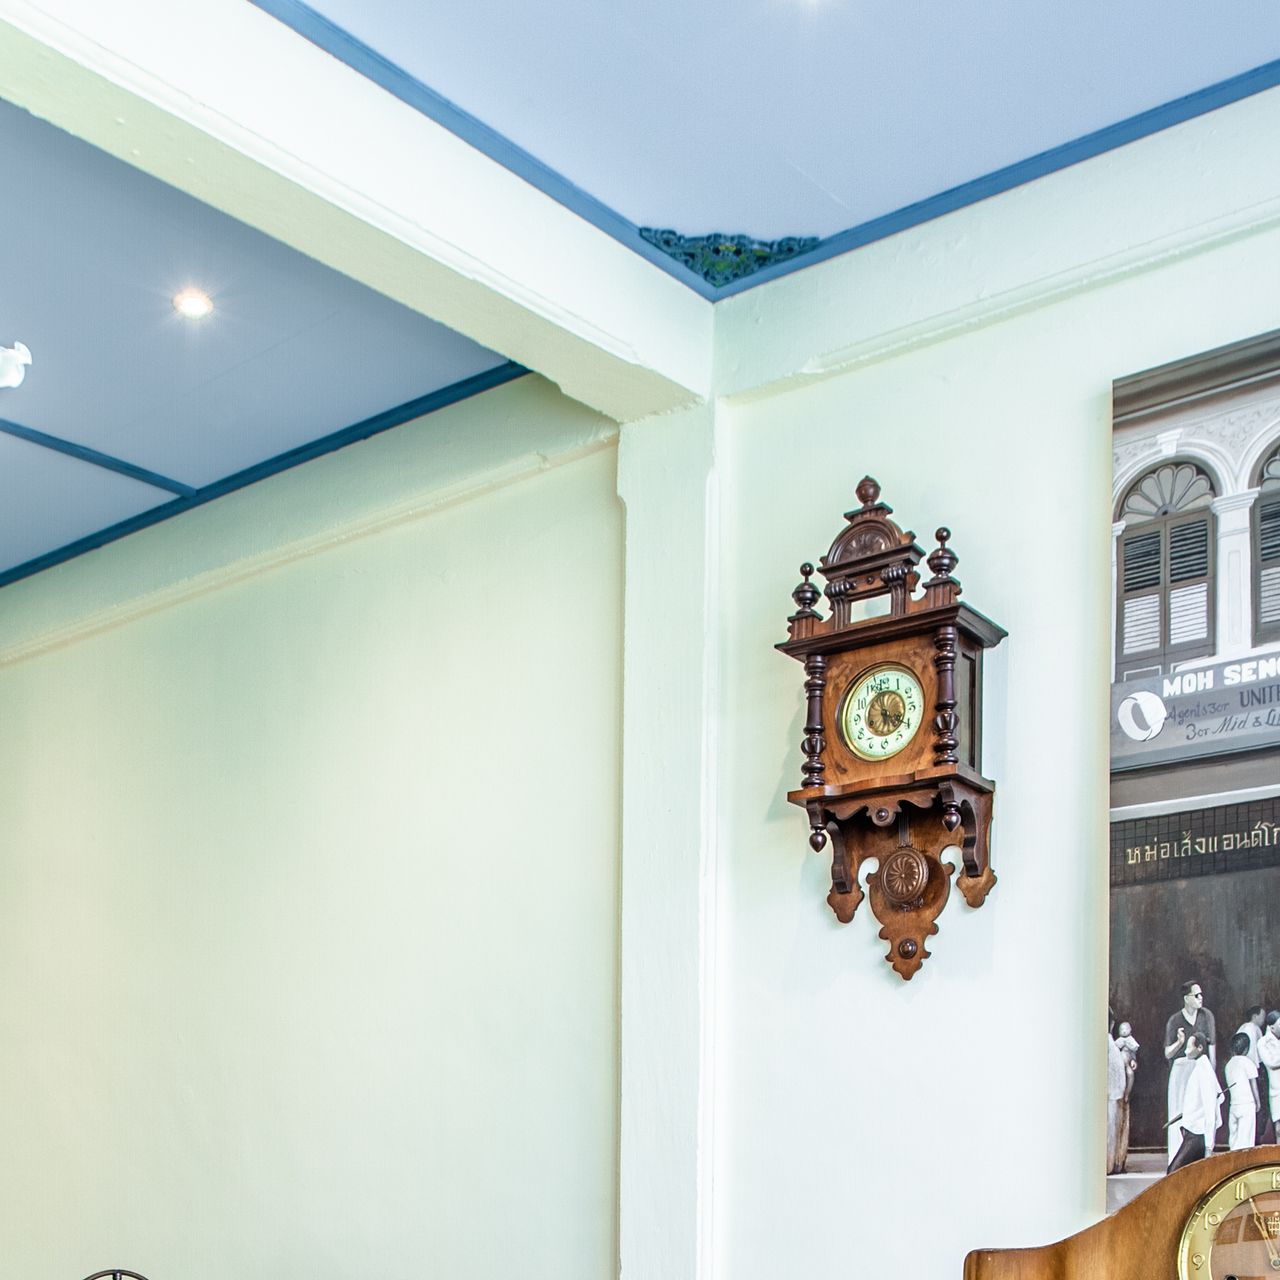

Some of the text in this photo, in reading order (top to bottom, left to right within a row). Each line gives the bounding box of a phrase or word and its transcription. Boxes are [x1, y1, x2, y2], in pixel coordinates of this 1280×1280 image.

[1163, 669, 1214, 698] MOH
[1235, 1182, 1245, 1200] 11
[1204, 1212, 1221, 1230] 10
[1192, 1254, 1205, 1270] 9
